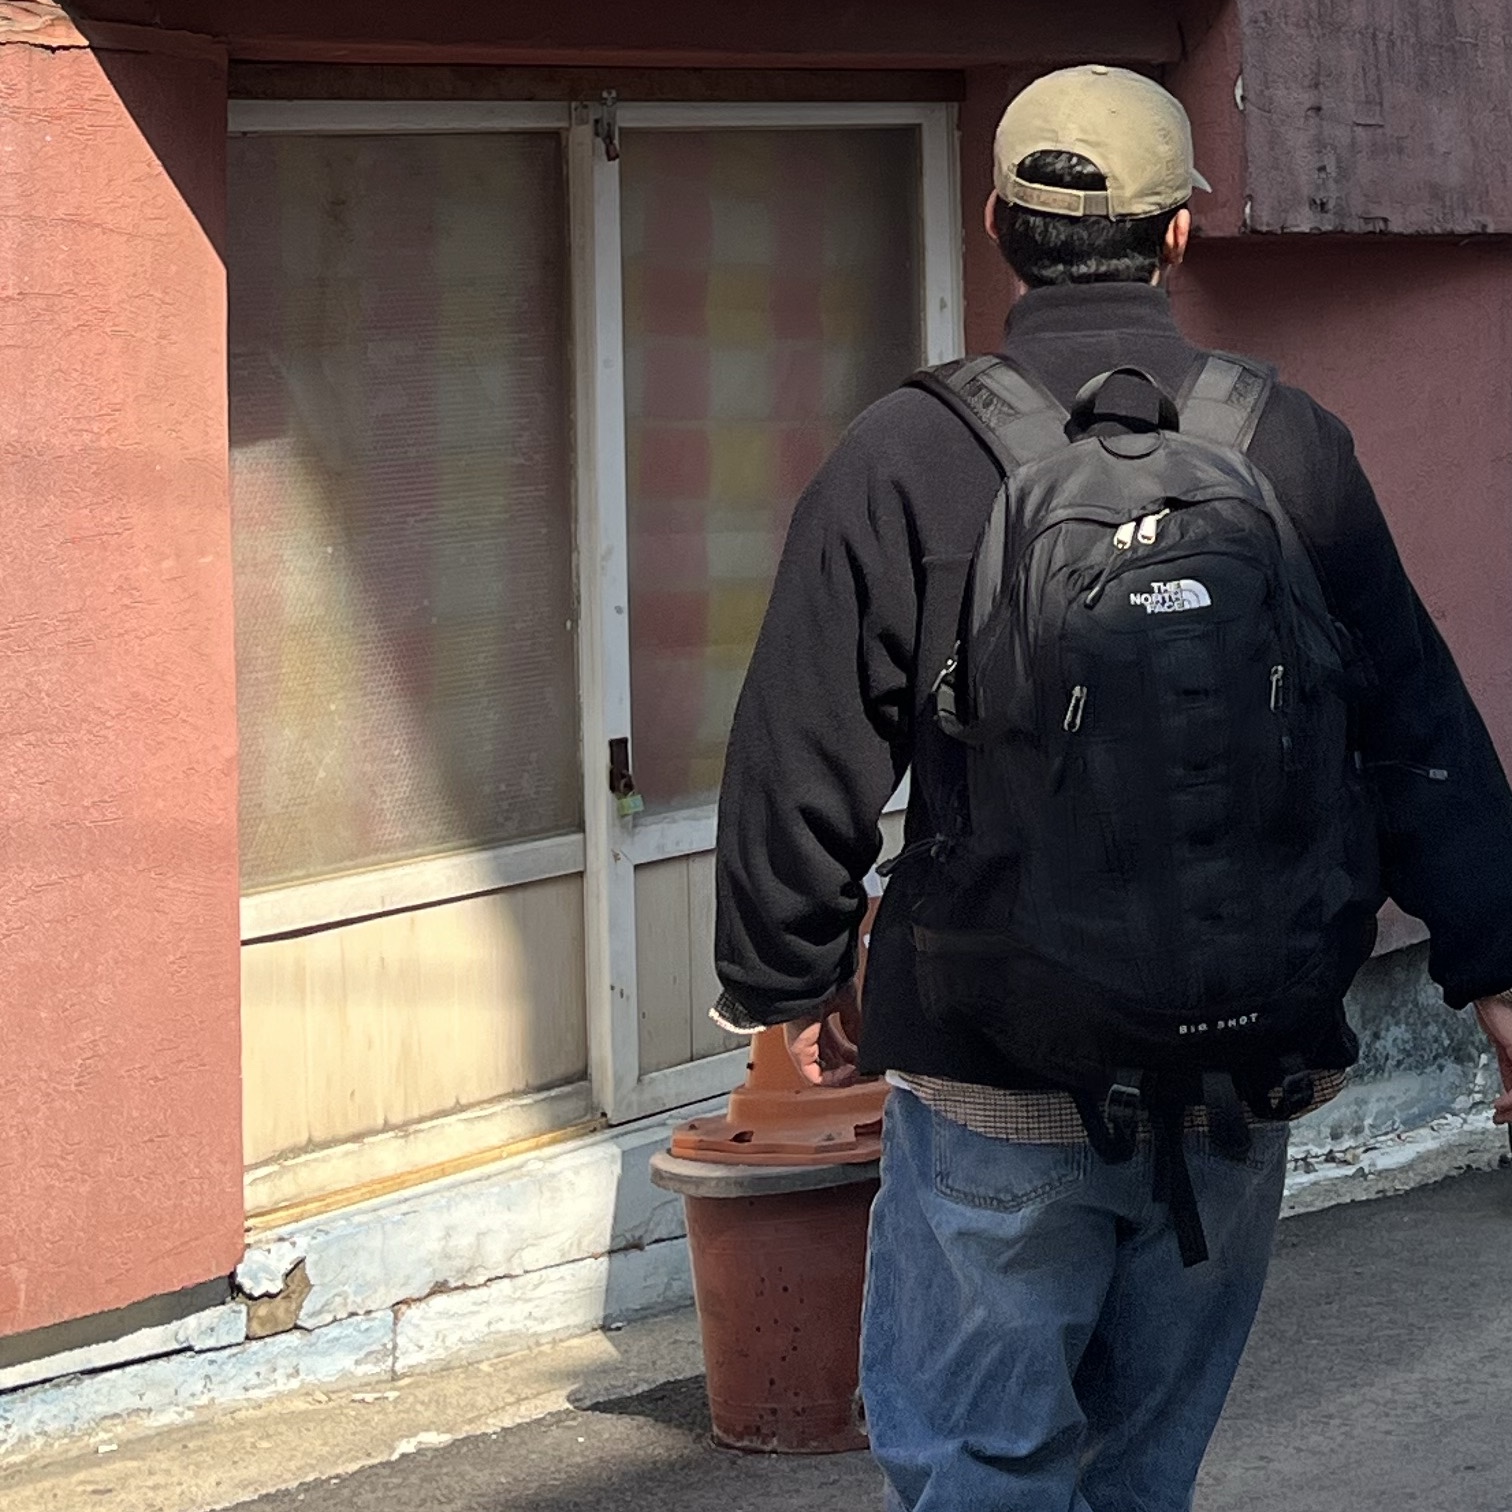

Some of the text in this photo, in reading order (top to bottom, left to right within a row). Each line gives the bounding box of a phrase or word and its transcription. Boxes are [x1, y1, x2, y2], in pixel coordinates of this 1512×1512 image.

[1150, 580, 1181, 594] THE
[1129, 591, 1183, 606] NORTH
[1146, 600, 1185, 615] FACE
[1179, 1022, 1208, 1035] BIG
